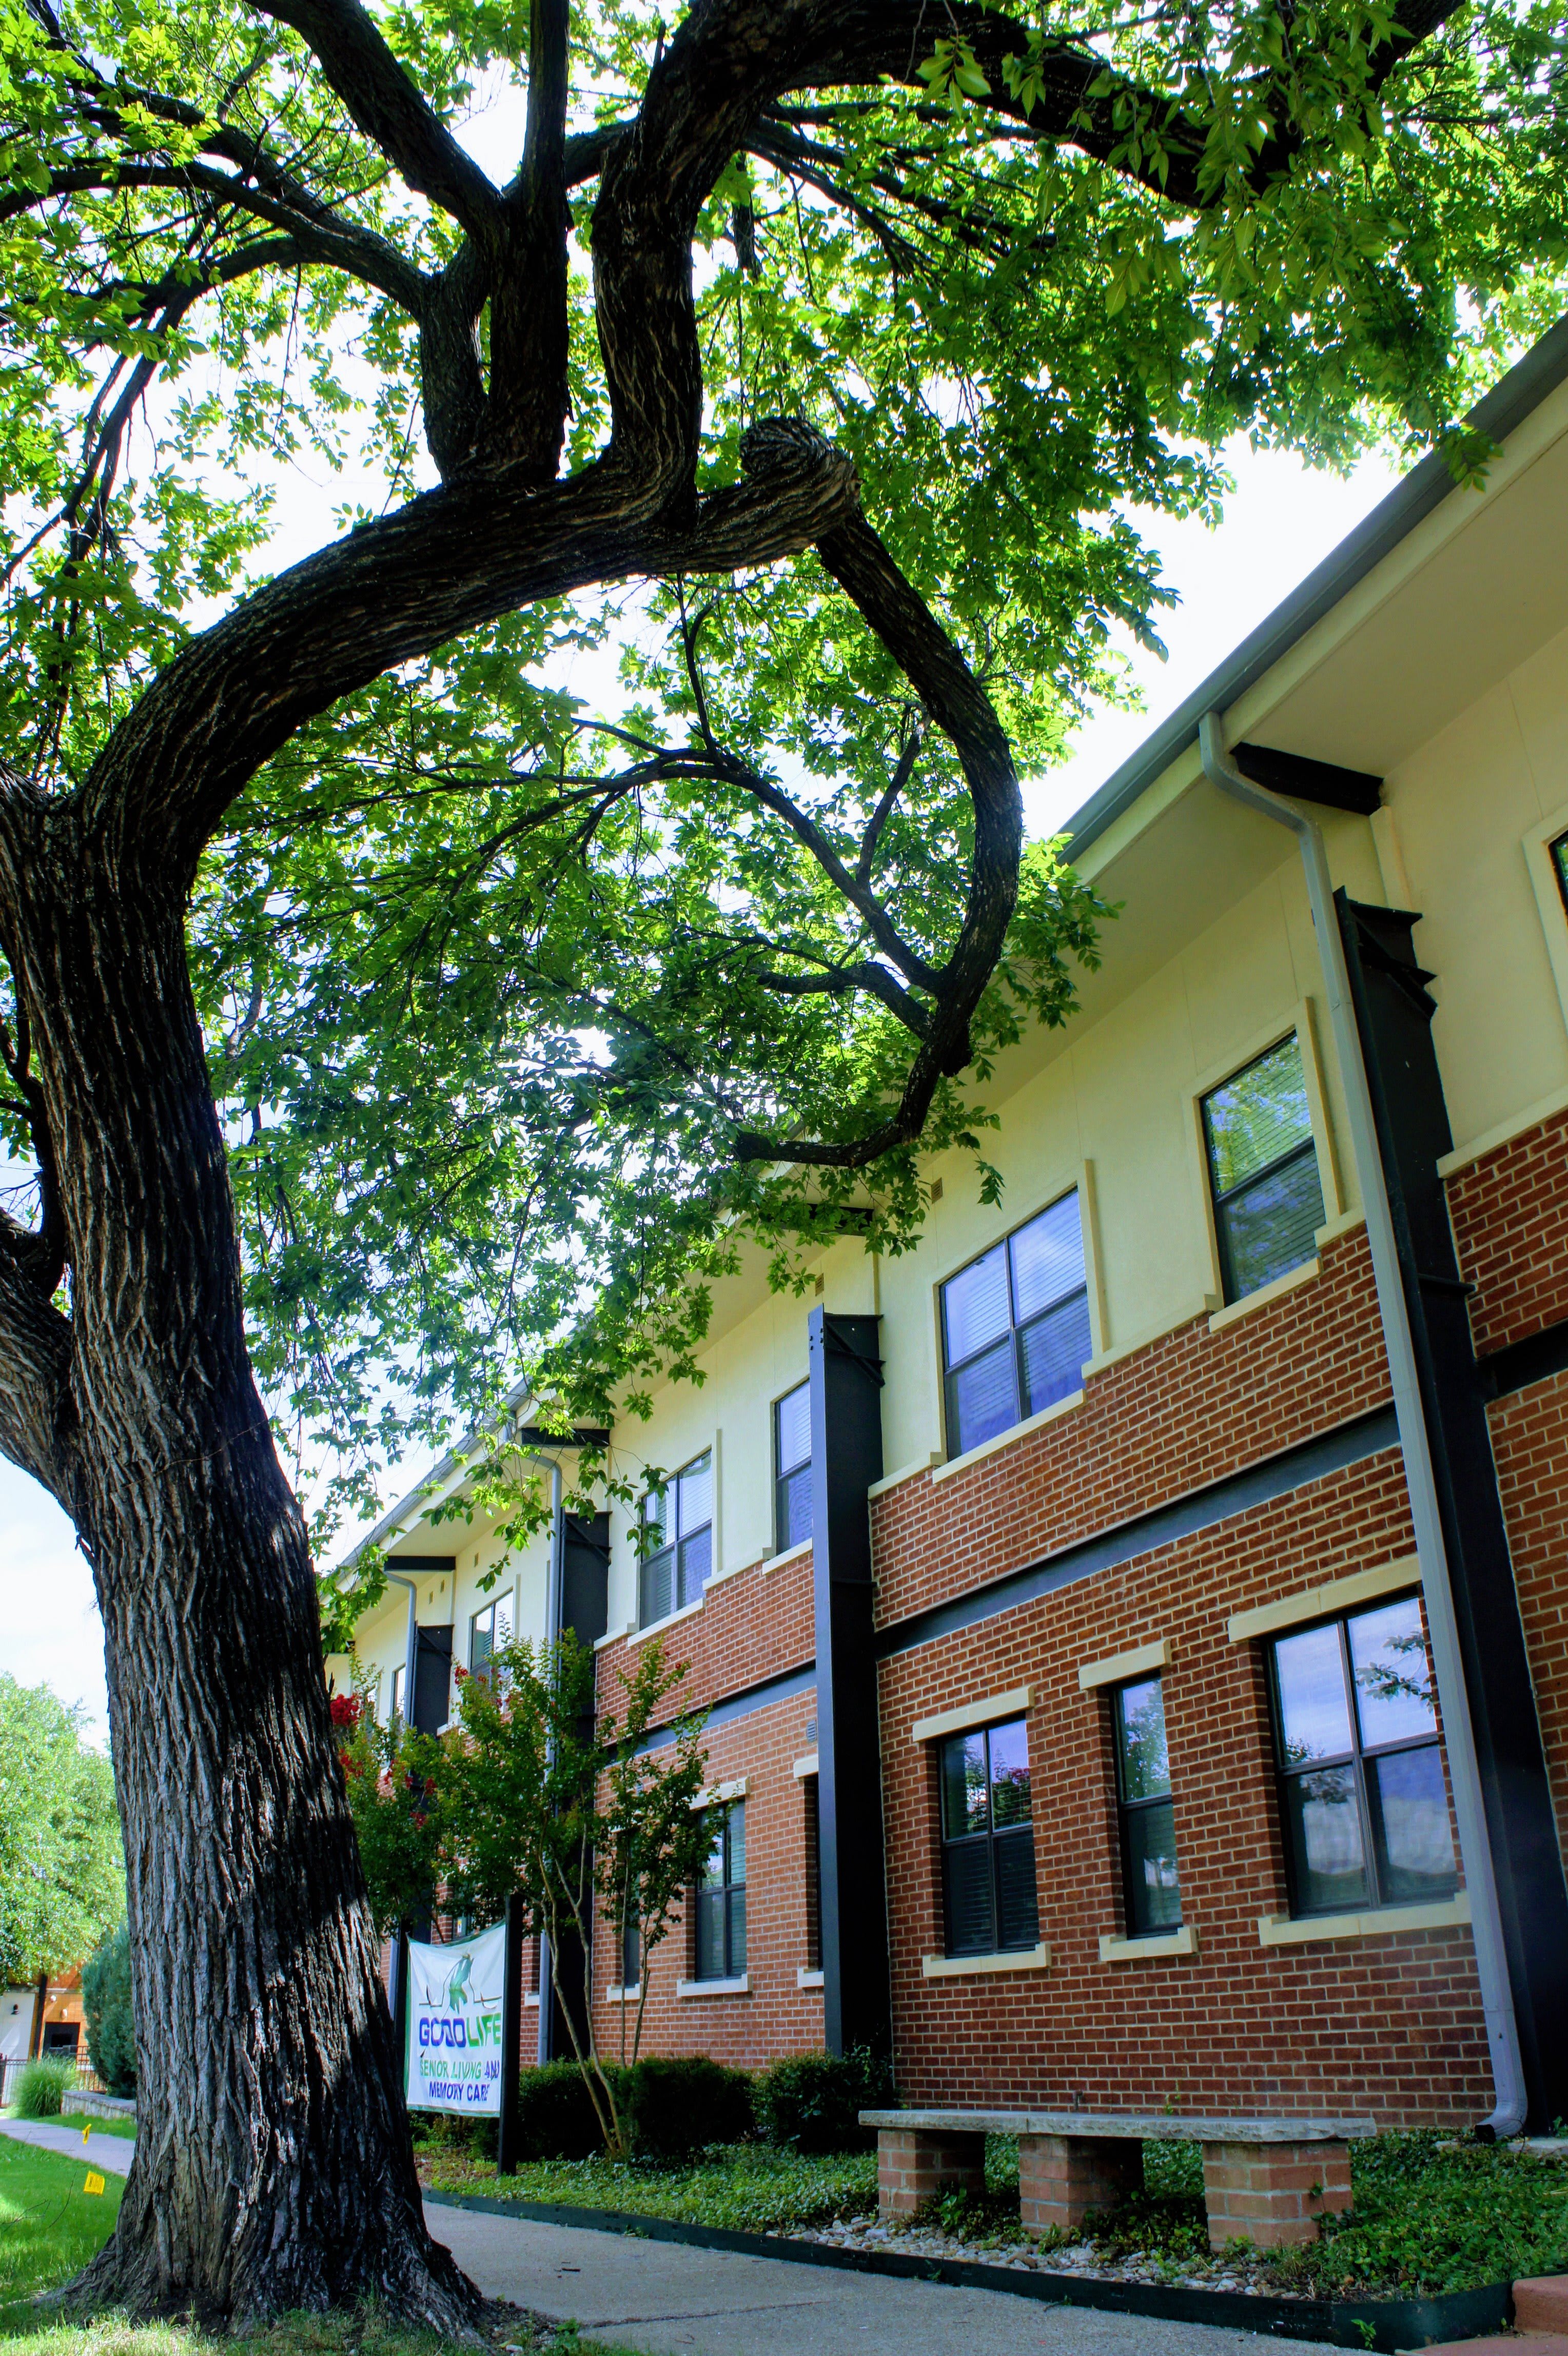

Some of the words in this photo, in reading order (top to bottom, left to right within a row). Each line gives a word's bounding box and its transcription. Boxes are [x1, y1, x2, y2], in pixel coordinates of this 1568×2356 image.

[420, 2059, 448, 2077] SENIOR
[450, 2060, 481, 2079] LIVING
[429, 2081, 464, 2100] MEMORY
[466, 2083, 490, 2102] CARE
